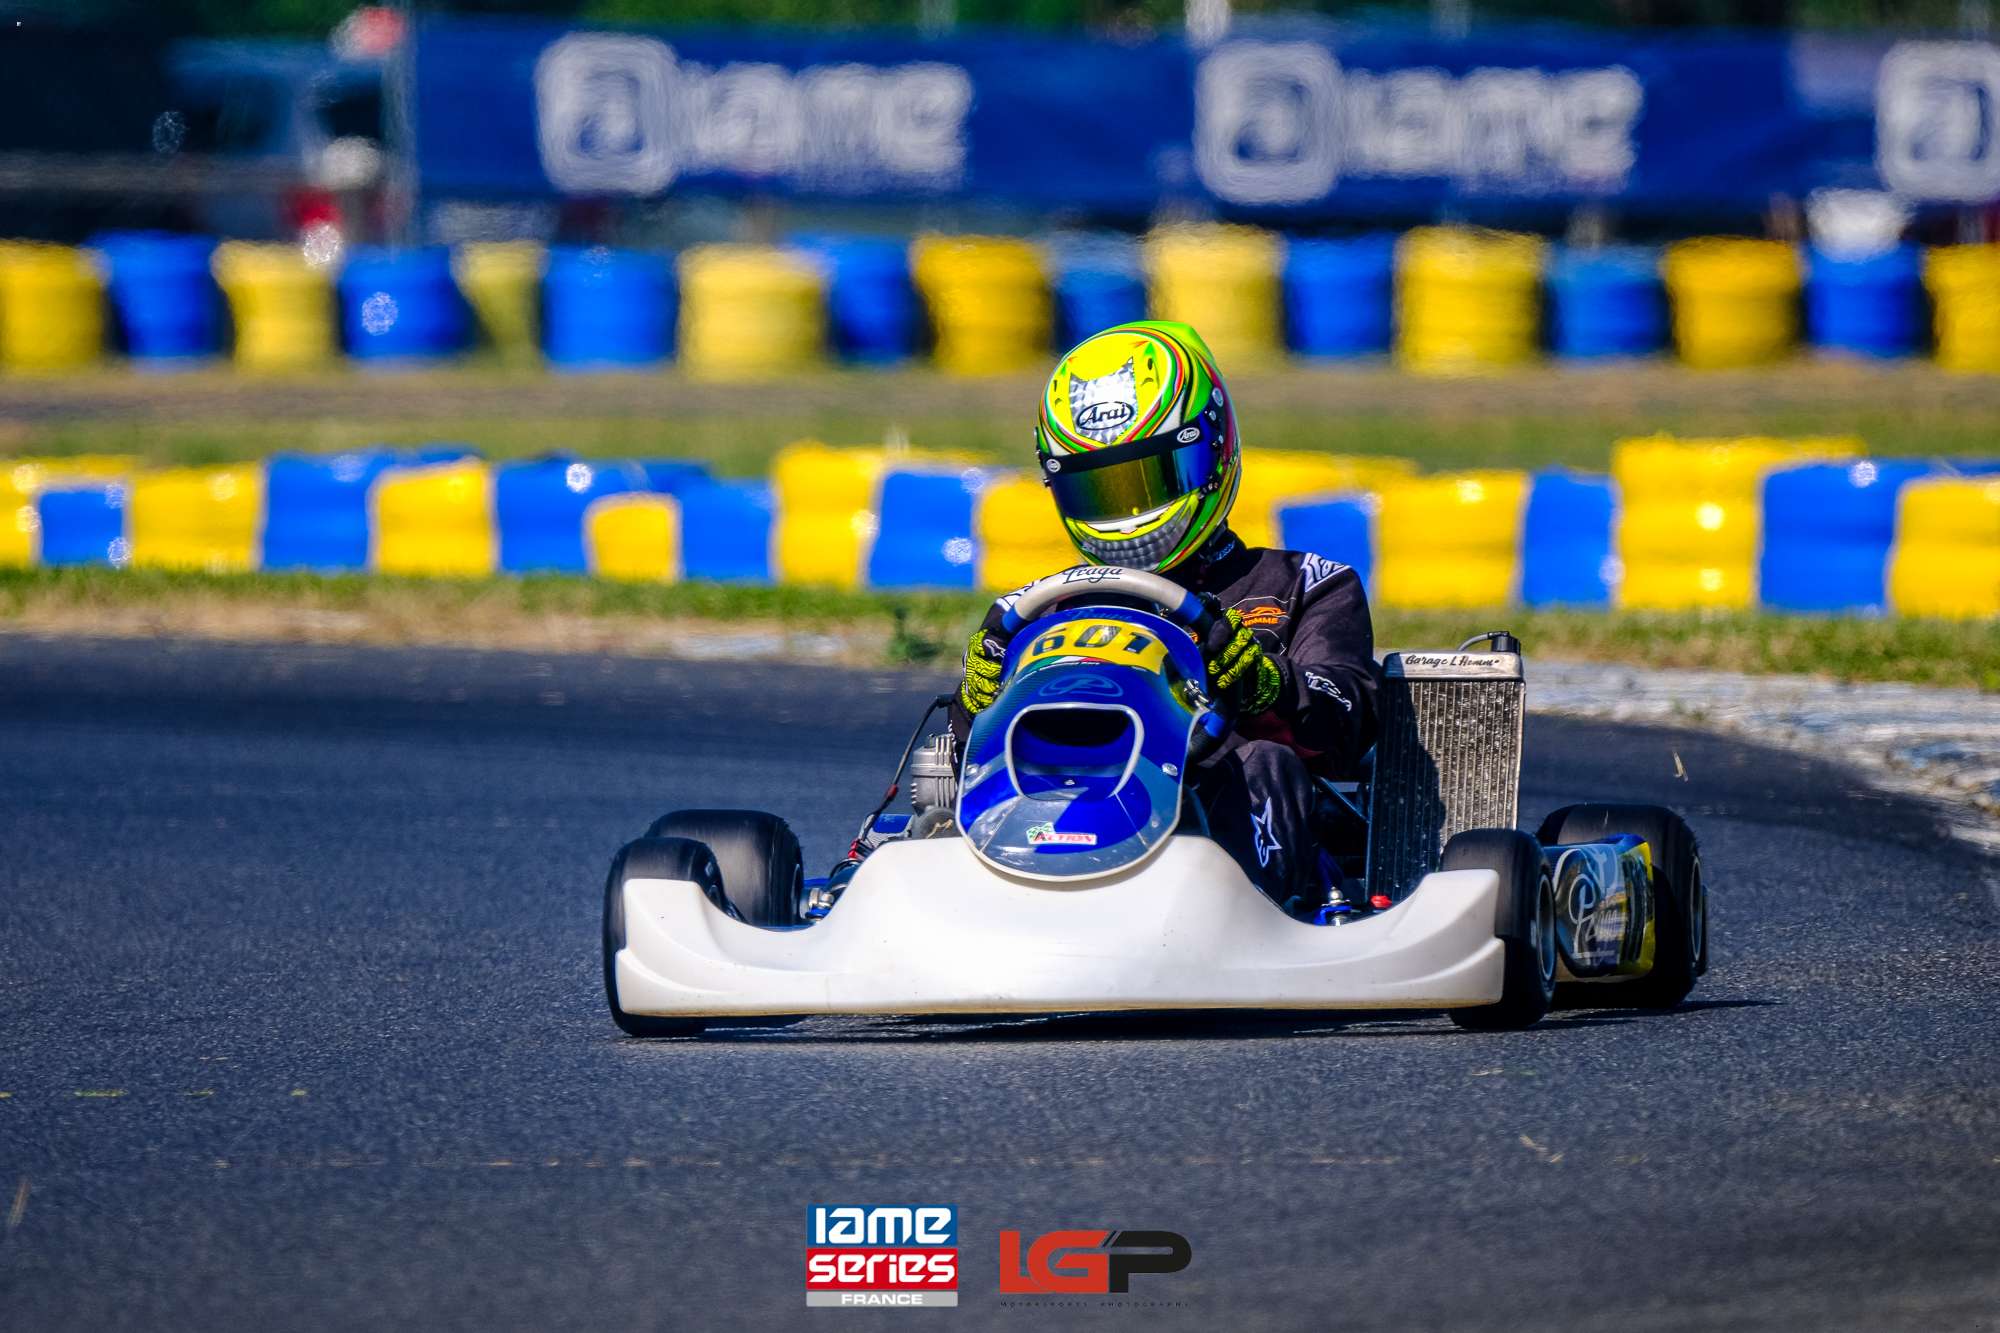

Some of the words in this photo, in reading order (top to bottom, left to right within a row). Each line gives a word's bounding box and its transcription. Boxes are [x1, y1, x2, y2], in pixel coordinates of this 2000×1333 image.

[1079, 403, 1129, 424] Arai
[1032, 625, 1152, 656] 601
[1405, 655, 1448, 668] Garage
